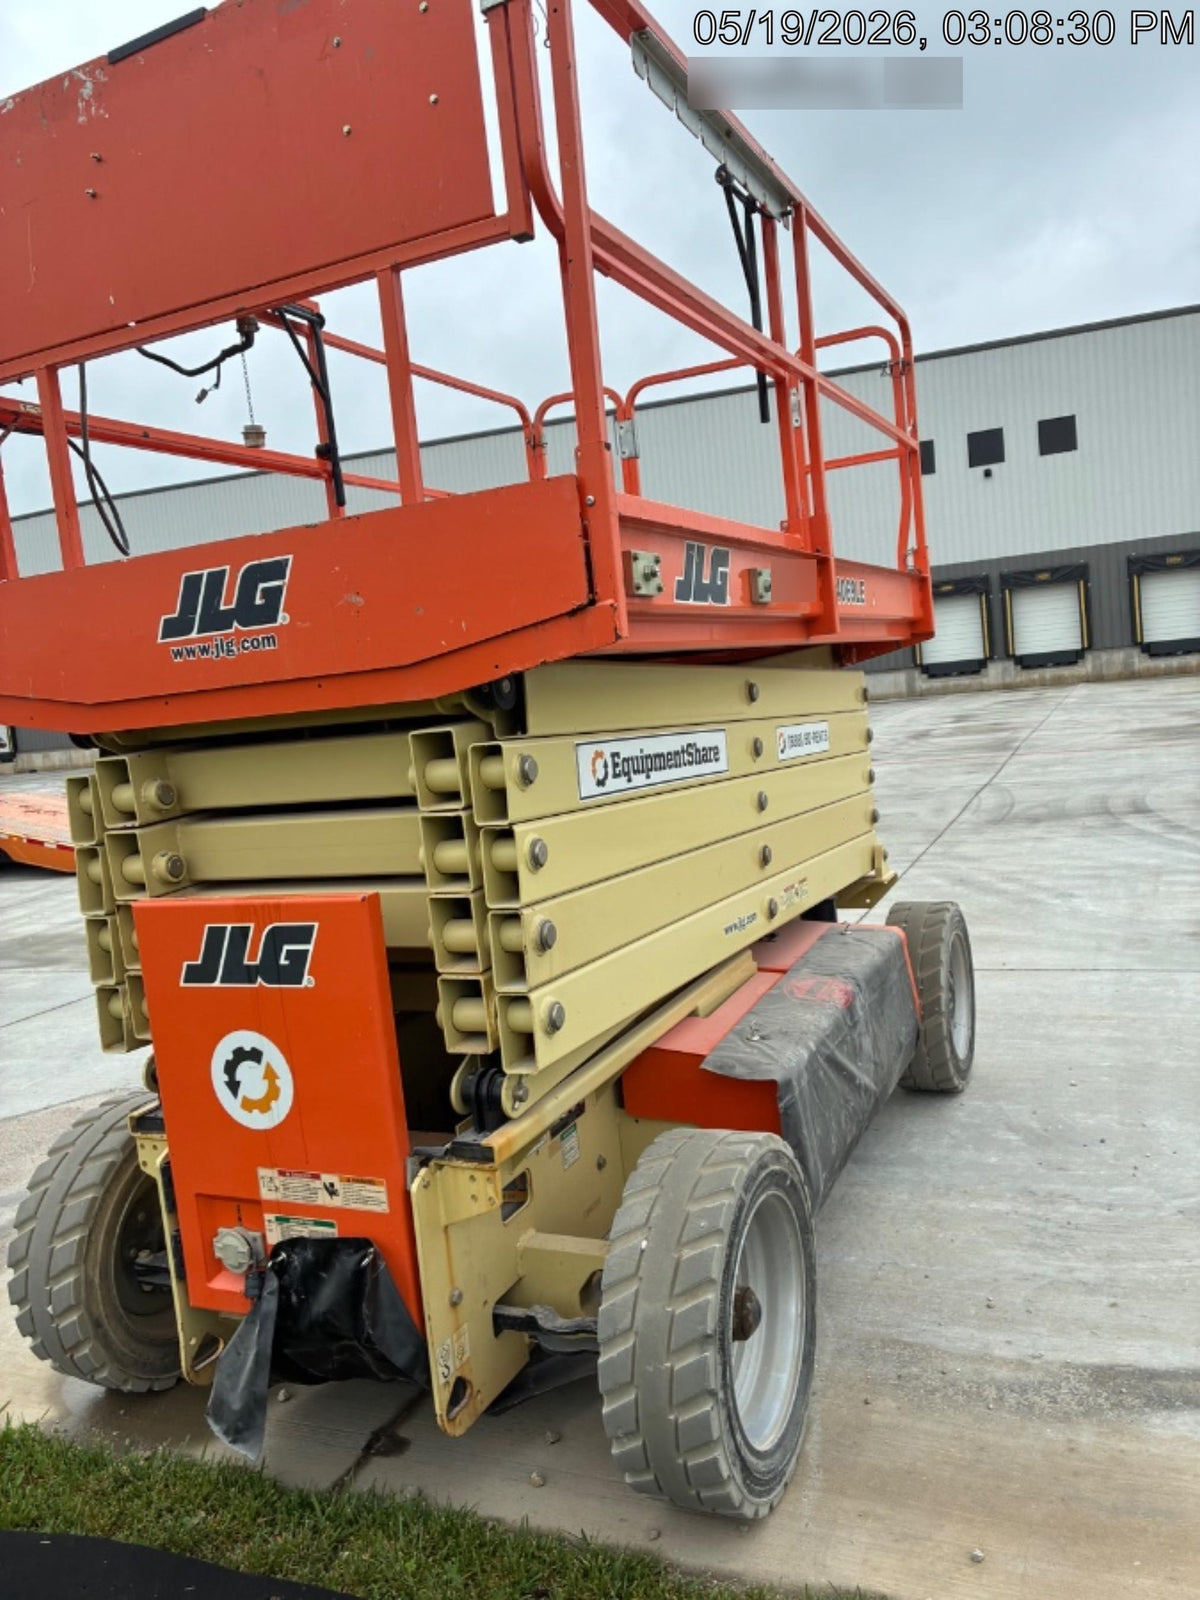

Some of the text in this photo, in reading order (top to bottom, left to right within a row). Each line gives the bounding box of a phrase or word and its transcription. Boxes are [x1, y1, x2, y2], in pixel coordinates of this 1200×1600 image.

[157, 554, 294, 643] JLG
[673, 540, 731, 606] JLG
[171, 633, 277, 662] www.jlg.com
[610, 742, 721, 783] EquipmentShare
[179, 922, 319, 988] JLG
